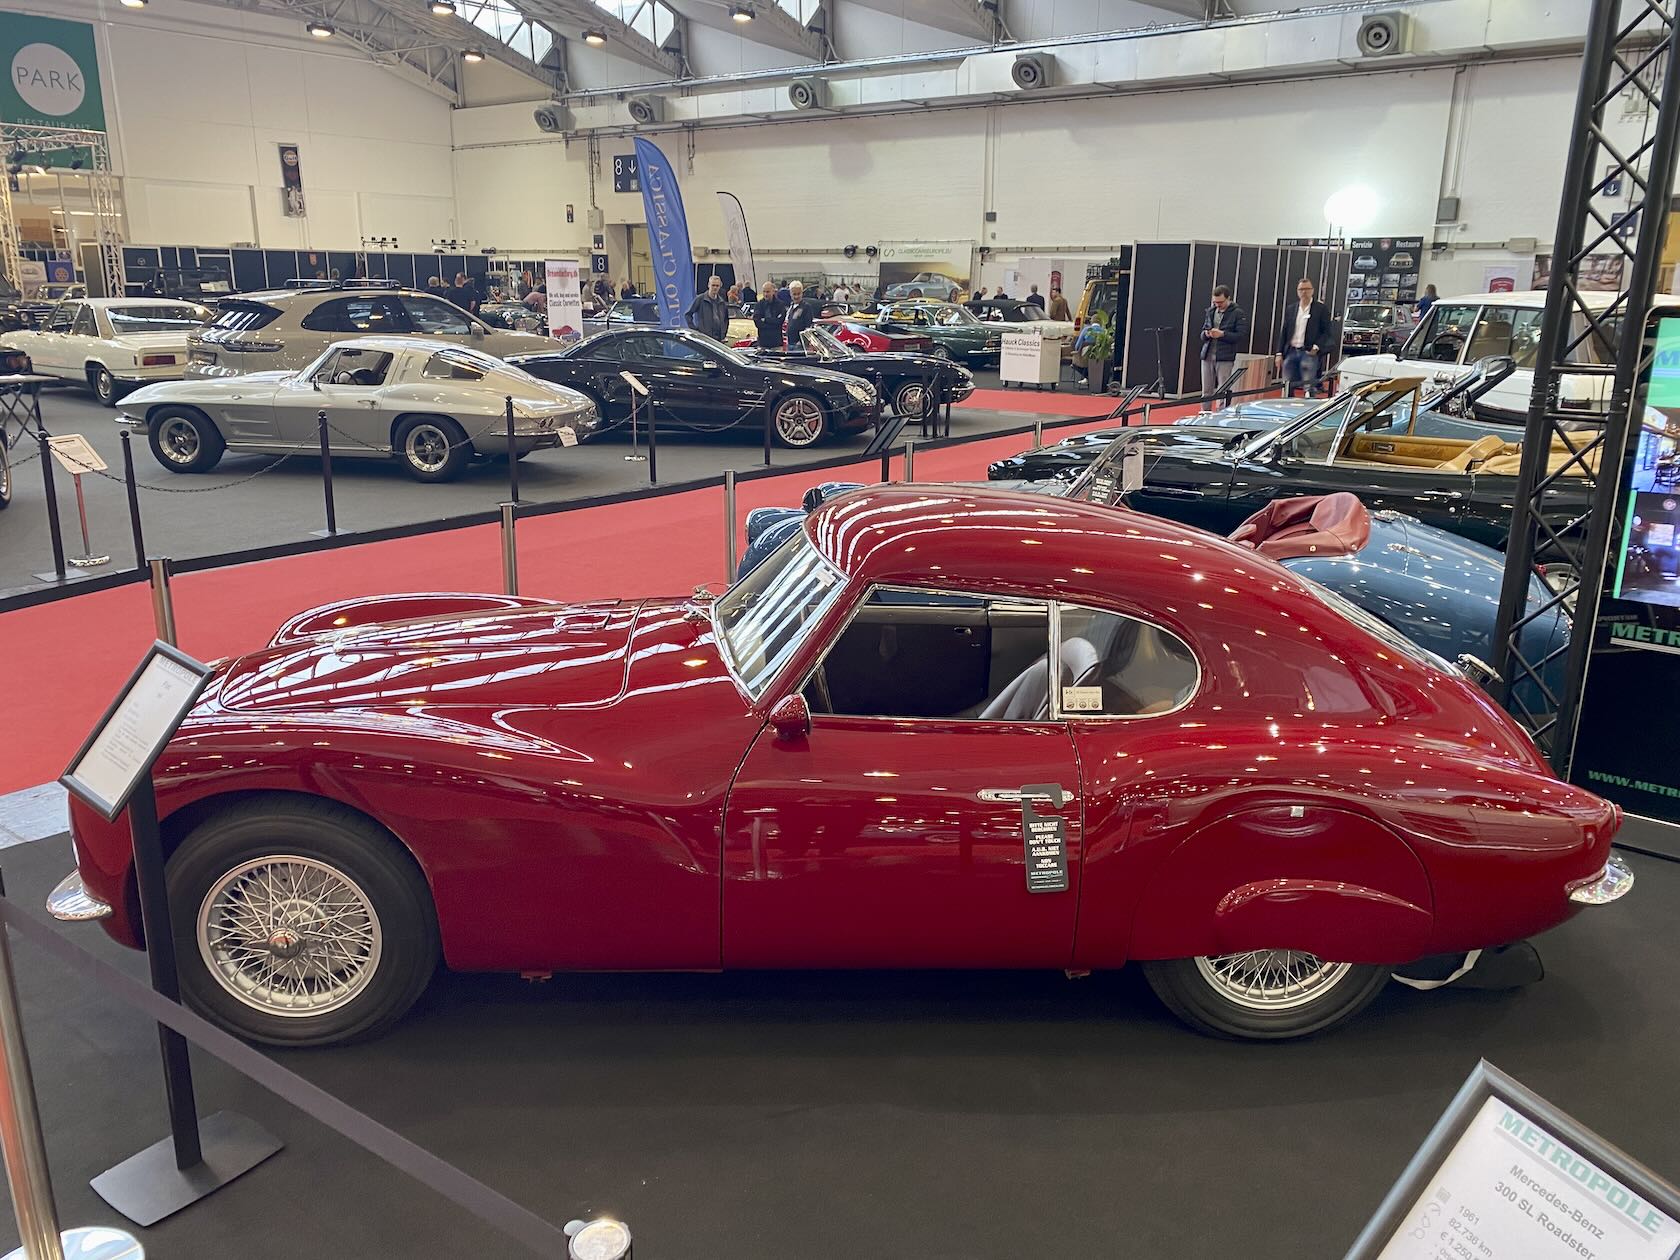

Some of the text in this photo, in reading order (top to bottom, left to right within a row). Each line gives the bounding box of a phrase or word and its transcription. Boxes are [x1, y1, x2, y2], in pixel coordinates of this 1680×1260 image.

[16, 66, 81, 92] PARK
[615, 158, 623, 176] 8
[1352, 240, 1420, 249] Servizio Restauro
[597, 256, 605, 272] 8
[549, 299, 580, 307] Classic Corvettes
[1001, 337, 1040, 347] Hauck Classics
[1588, 770, 1680, 799] WWW.METR
[1499, 1111, 1665, 1234] METROPOLE
[1510, 1164, 1605, 1240] Mercedes-Benz
[1459, 1205, 1480, 1225] 1961
[1494, 1181, 1596, 1260] 300 SL Roadster
[1440, 1231, 1449, 1241] €
[1449, 1217, 1480, 1246] 82.736
[1478, 1241, 1493, 1258] km
